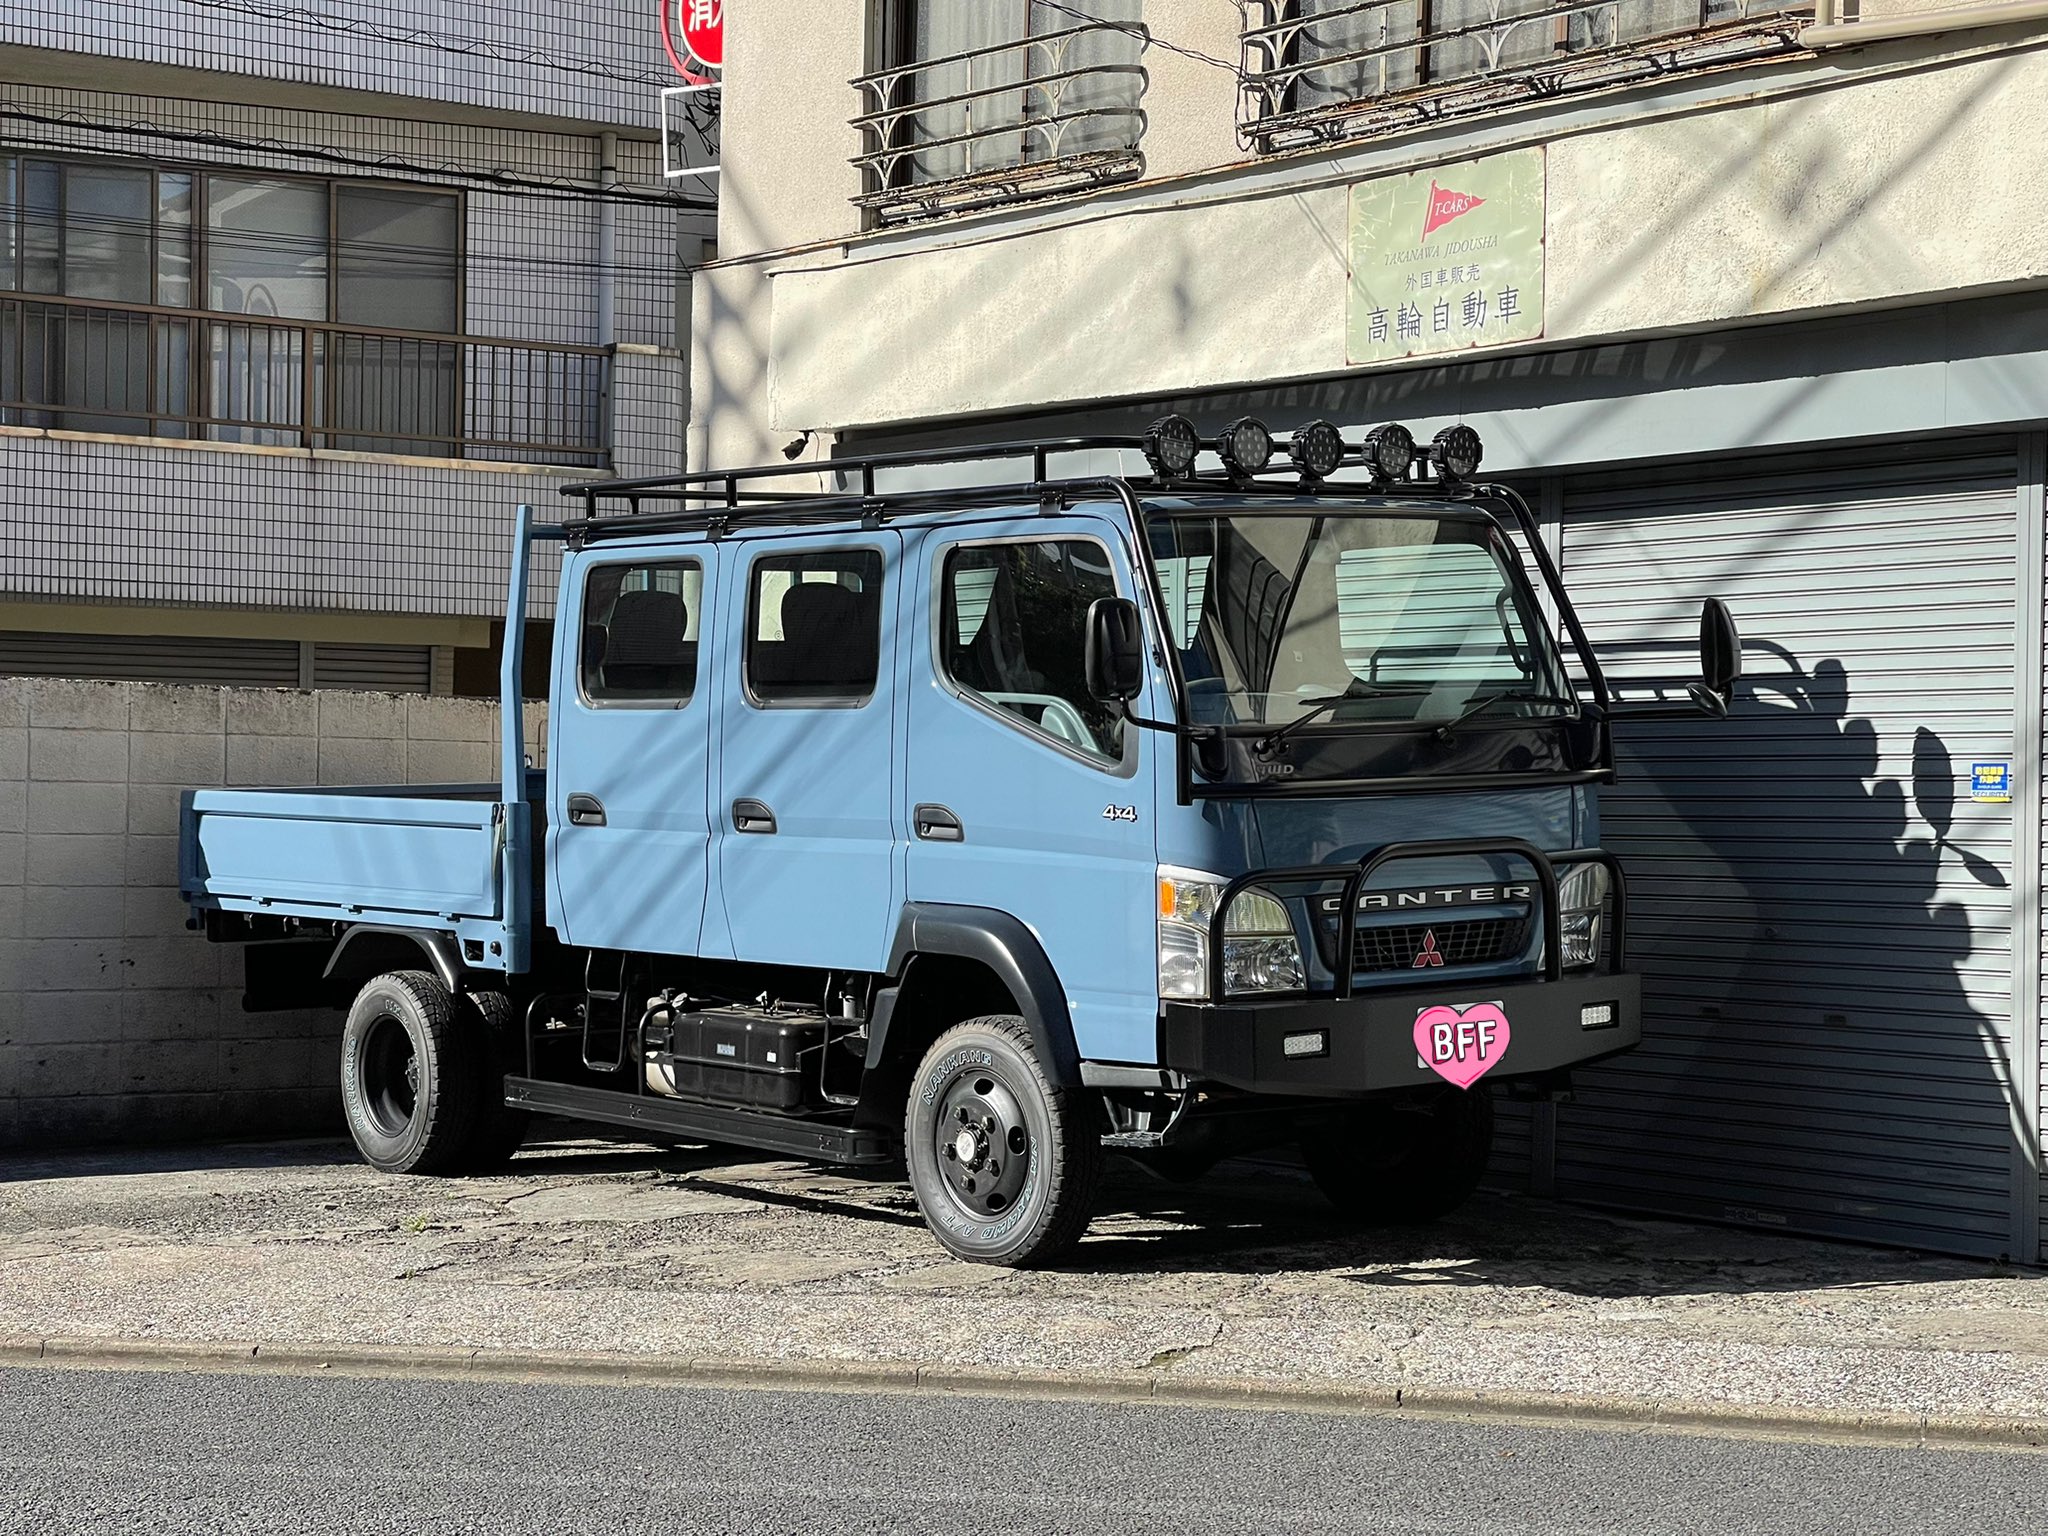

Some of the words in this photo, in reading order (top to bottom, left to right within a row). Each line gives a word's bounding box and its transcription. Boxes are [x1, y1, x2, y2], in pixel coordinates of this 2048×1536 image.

[1434, 197, 1470, 216] T-CARS
[1384, 245, 1440, 266] TAKANAWA
[1444, 235, 1498, 258] JIDOUSHA
[1405, 263, 1480, 291] 外国車販売
[1366, 284, 1521, 344] 高輪自動車
[1102, 804, 1137, 822] 4x4
[1322, 886, 1530, 911] CANTER
[921, 1050, 993, 1106] NANKANG
